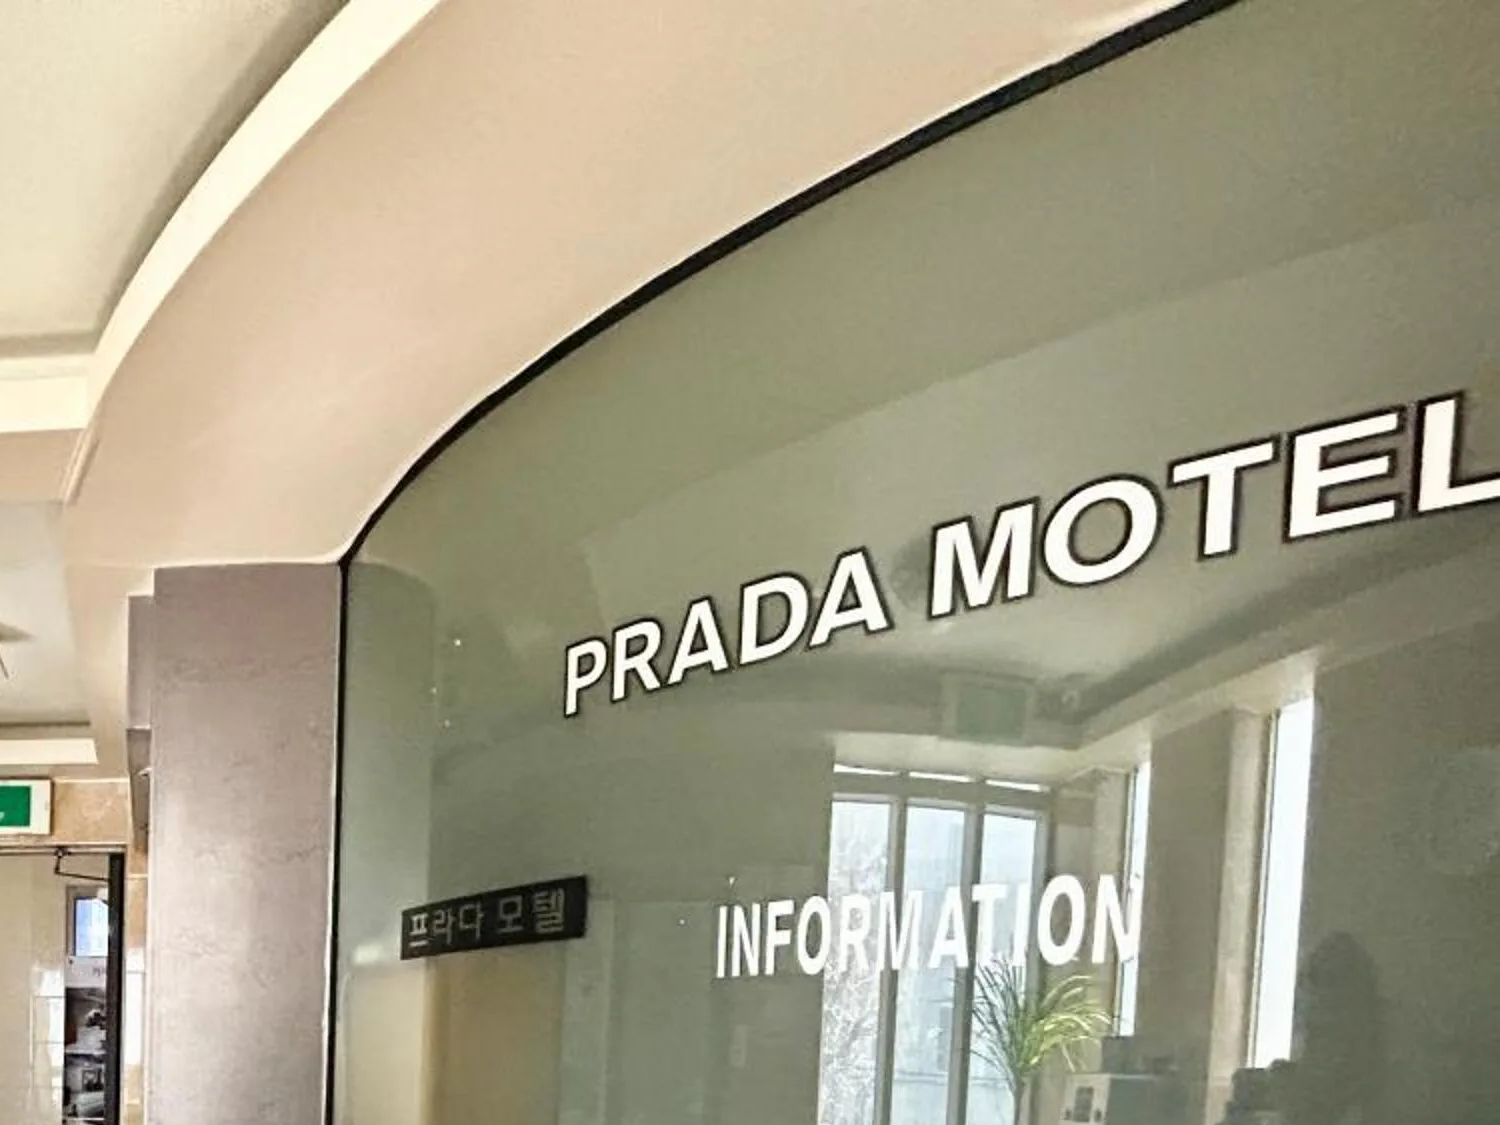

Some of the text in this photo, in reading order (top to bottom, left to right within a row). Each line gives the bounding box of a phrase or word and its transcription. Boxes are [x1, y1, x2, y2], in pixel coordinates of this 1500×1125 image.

[562, 390, 1500, 718] PRADA MOTEL
[409, 887, 565, 948] 프라다 모텔
[715, 873, 1146, 979] INFORMATION
